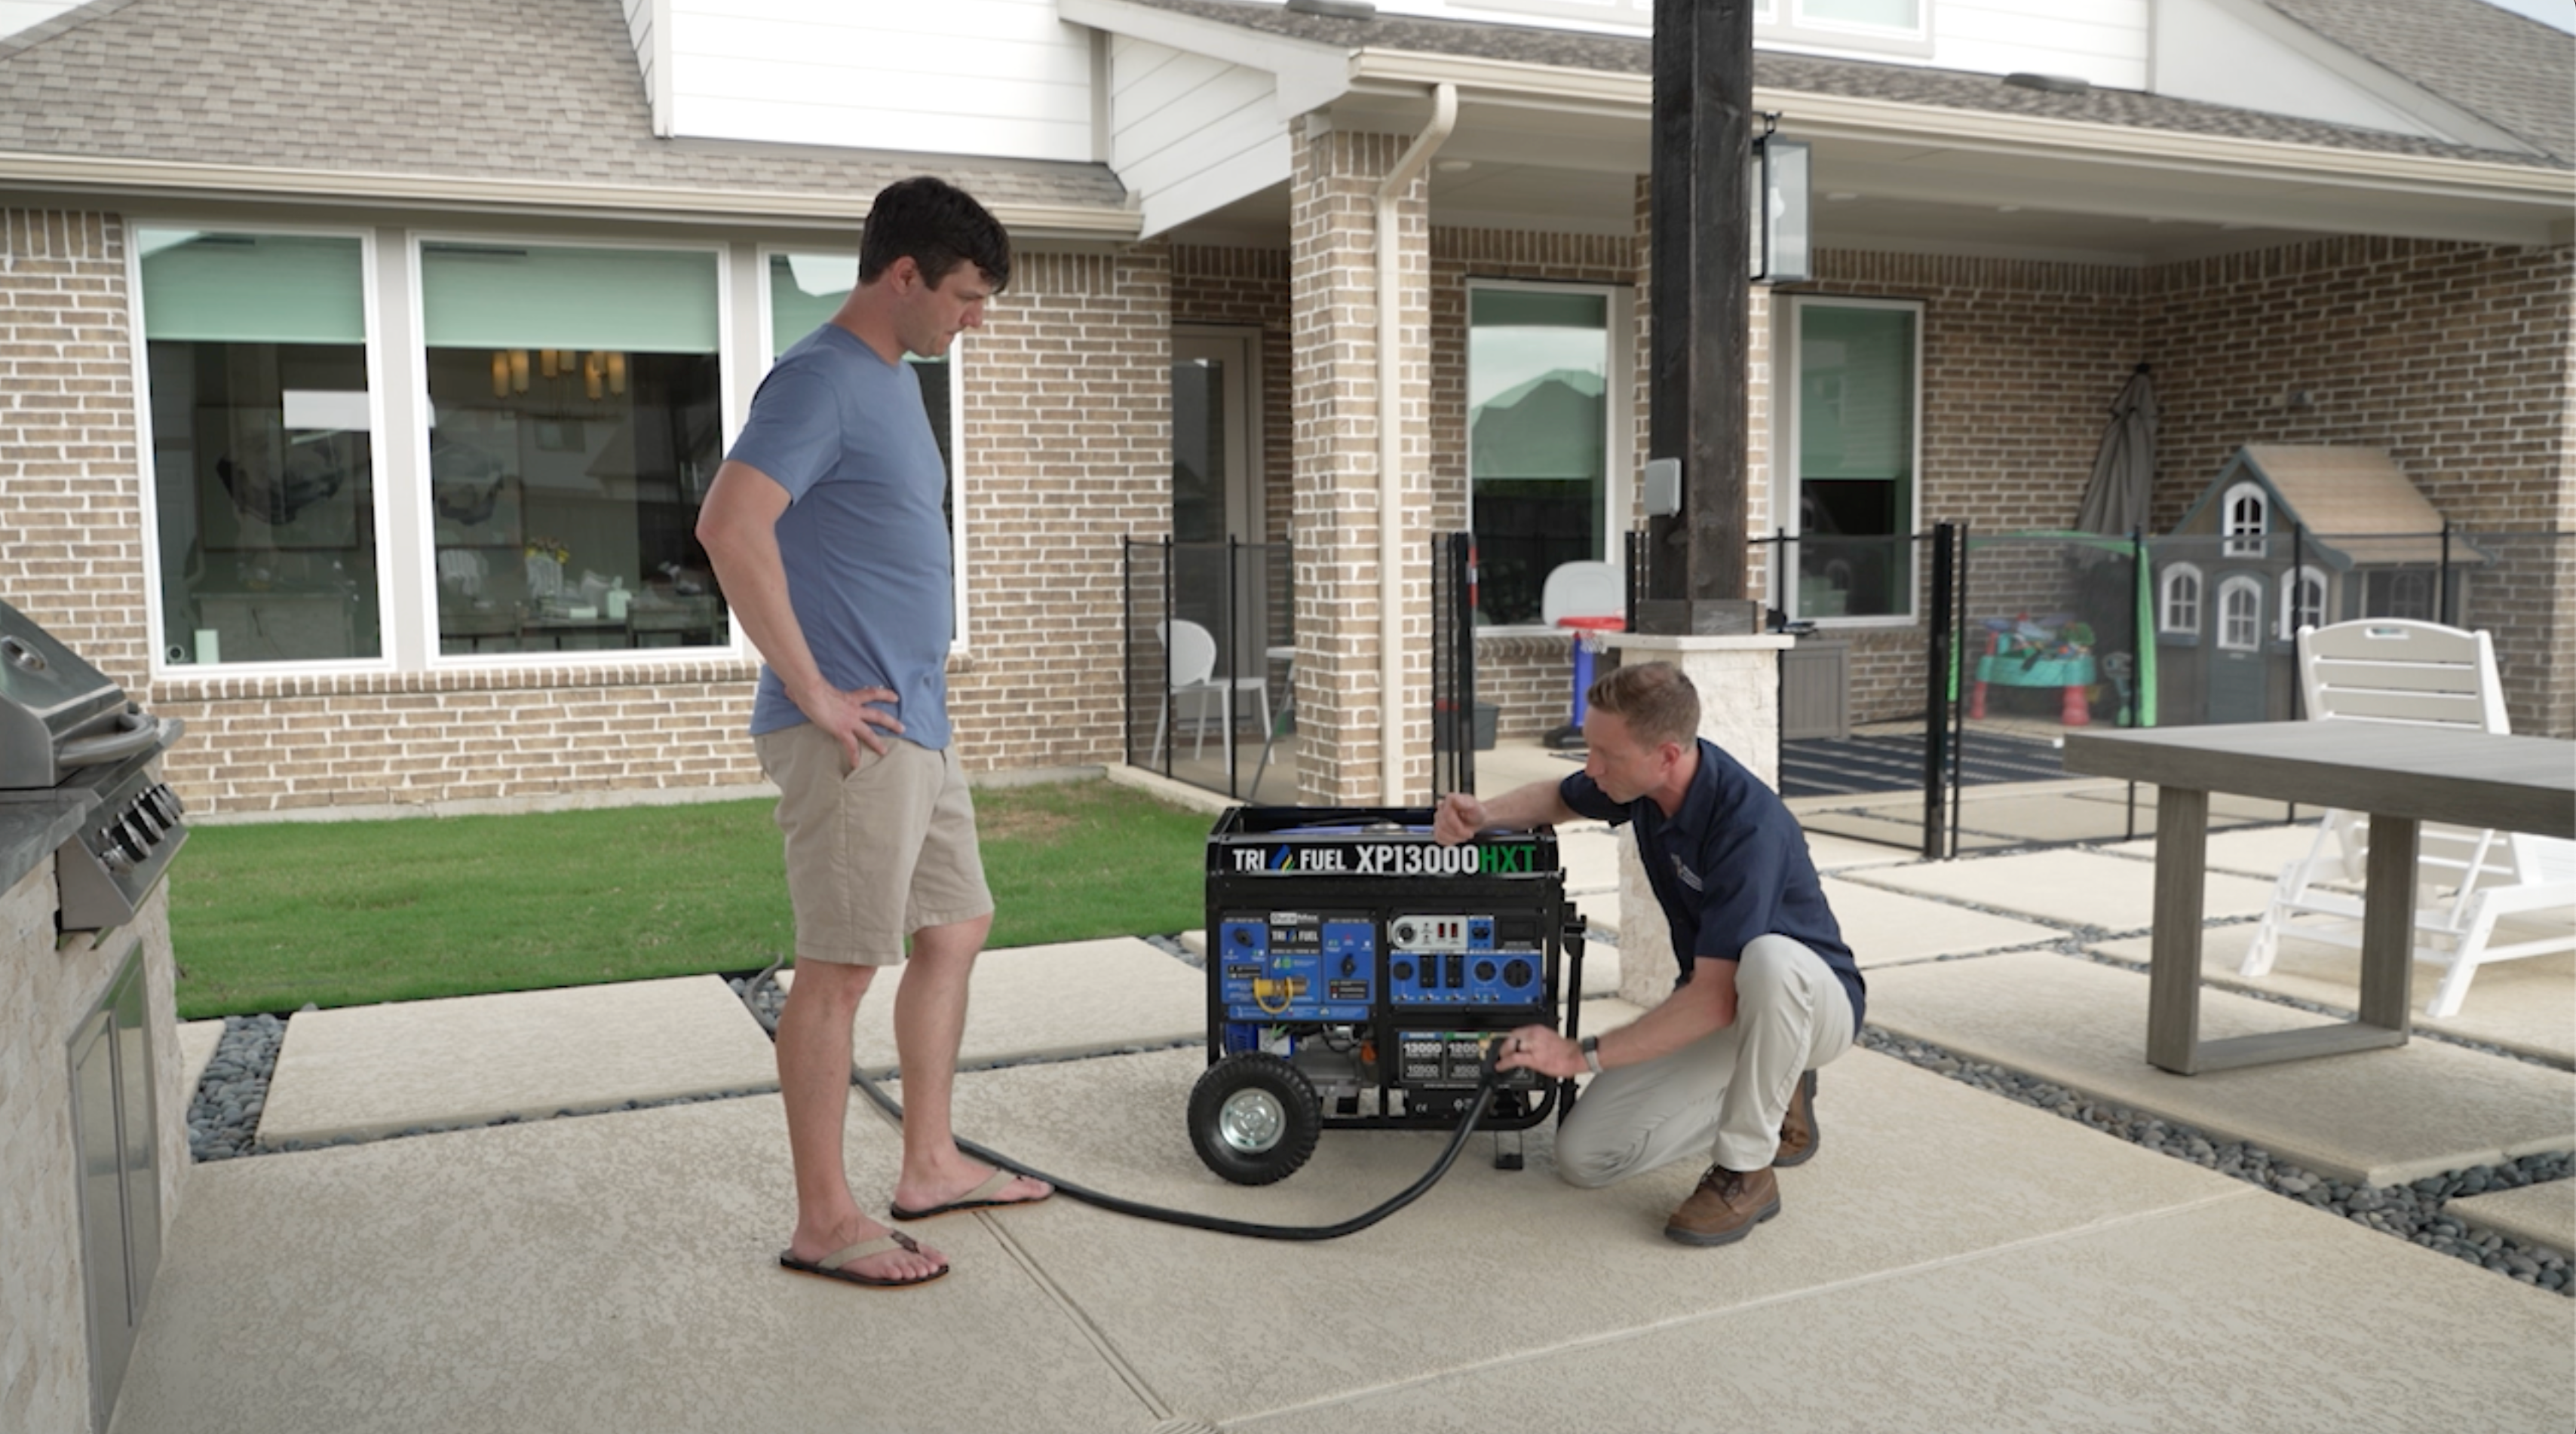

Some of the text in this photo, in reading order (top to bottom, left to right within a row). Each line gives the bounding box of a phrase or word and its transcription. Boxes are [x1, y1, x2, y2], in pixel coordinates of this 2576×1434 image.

[1233, 849, 1265, 871] TRI
[1299, 849, 1348, 871] FUEL
[1298, 930, 1320, 942] FUEL
[1403, 1042, 1443, 1053] 13000
